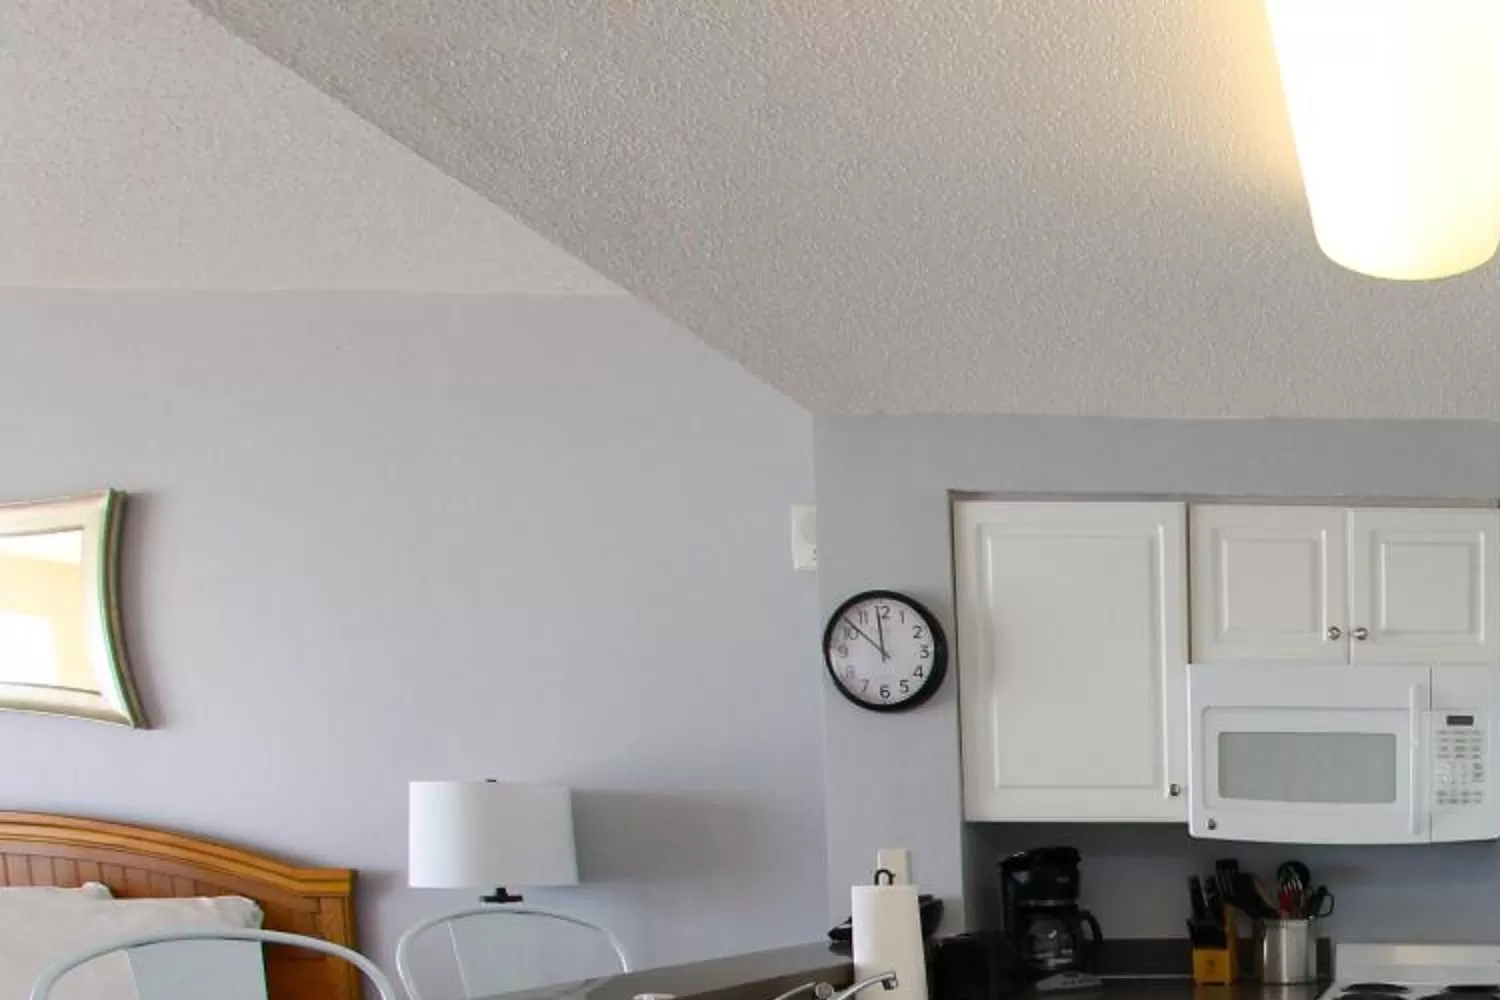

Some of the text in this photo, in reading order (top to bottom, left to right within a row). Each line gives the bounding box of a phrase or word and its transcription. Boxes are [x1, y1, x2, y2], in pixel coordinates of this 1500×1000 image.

[859, 611, 868, 624] 11
[913, 625, 923, 639] 2
[839, 644, 848, 658] 9
[920, 644, 930, 659] 3
[913, 665, 923, 678] 4
[861, 680, 869, 693] 7
[880, 685, 891, 699] 6
[900, 680, 909, 693] 5
